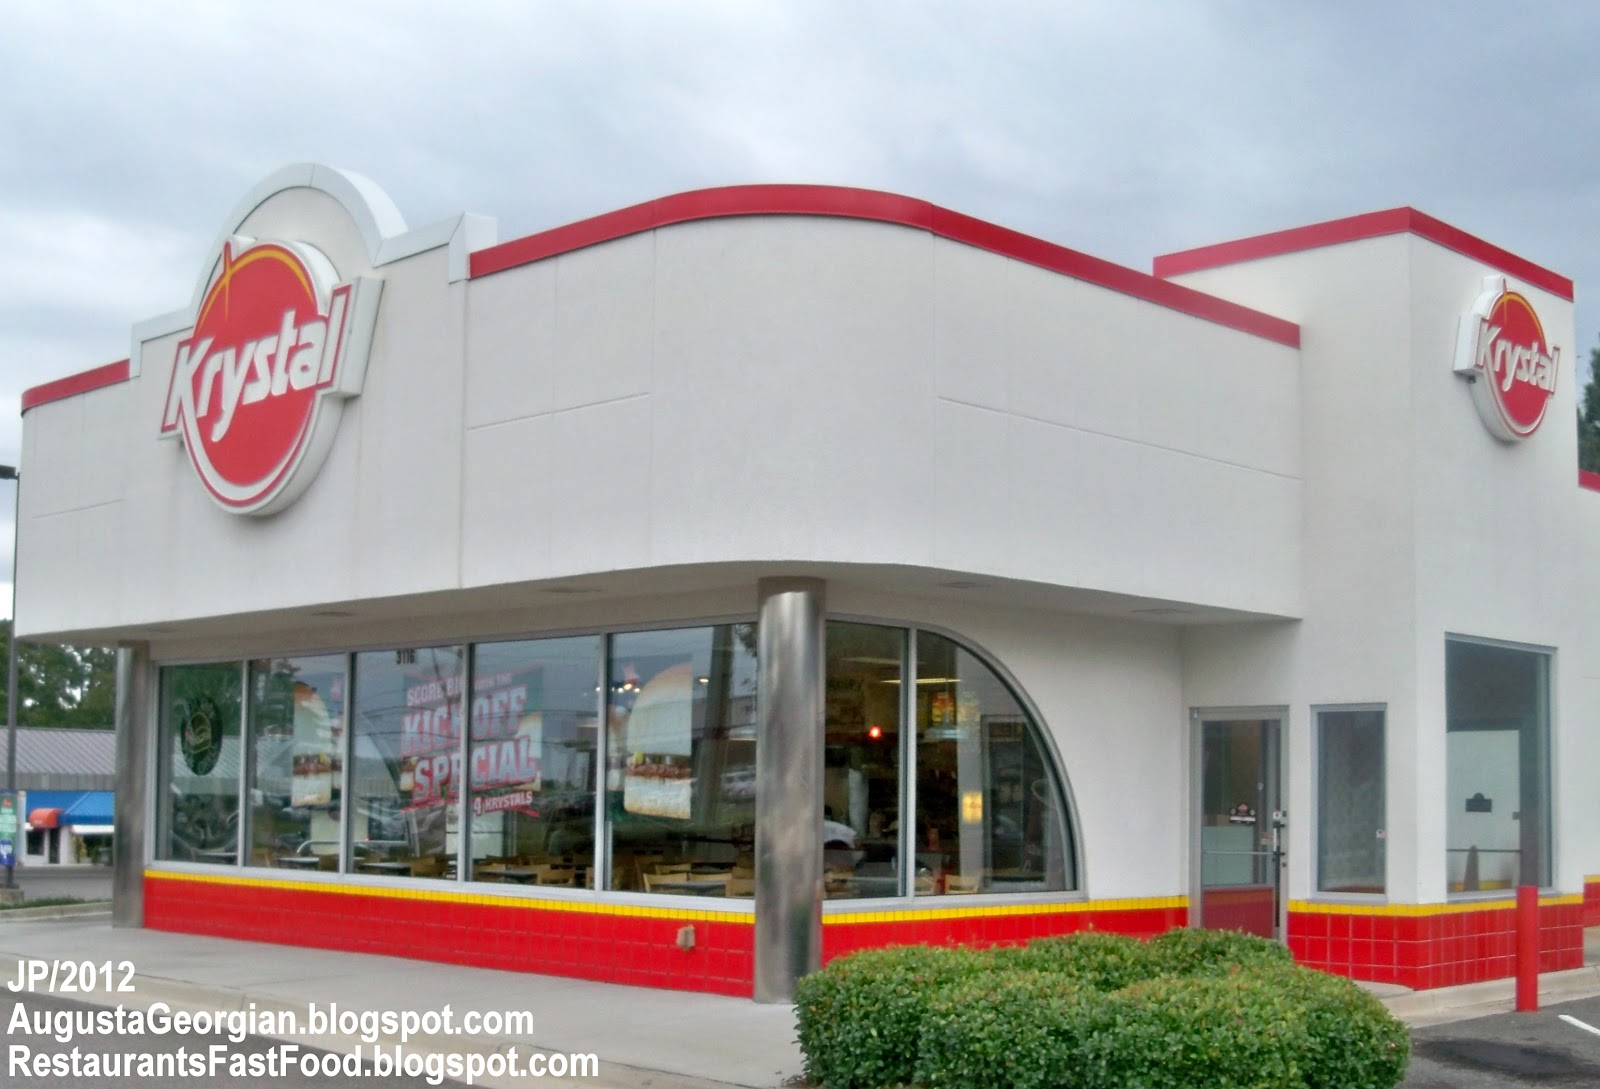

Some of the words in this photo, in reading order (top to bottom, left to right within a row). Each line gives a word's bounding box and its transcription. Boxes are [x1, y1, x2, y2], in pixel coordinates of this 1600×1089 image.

[161, 287, 350, 443] Krystal
[1475, 320, 1560, 394] Krystal
[407, 682, 443, 706] SCORE
[471, 686, 527, 738] OFF
[414, 738, 536, 799] SPECIAL
[484, 790, 534, 811] KRYSTALS
